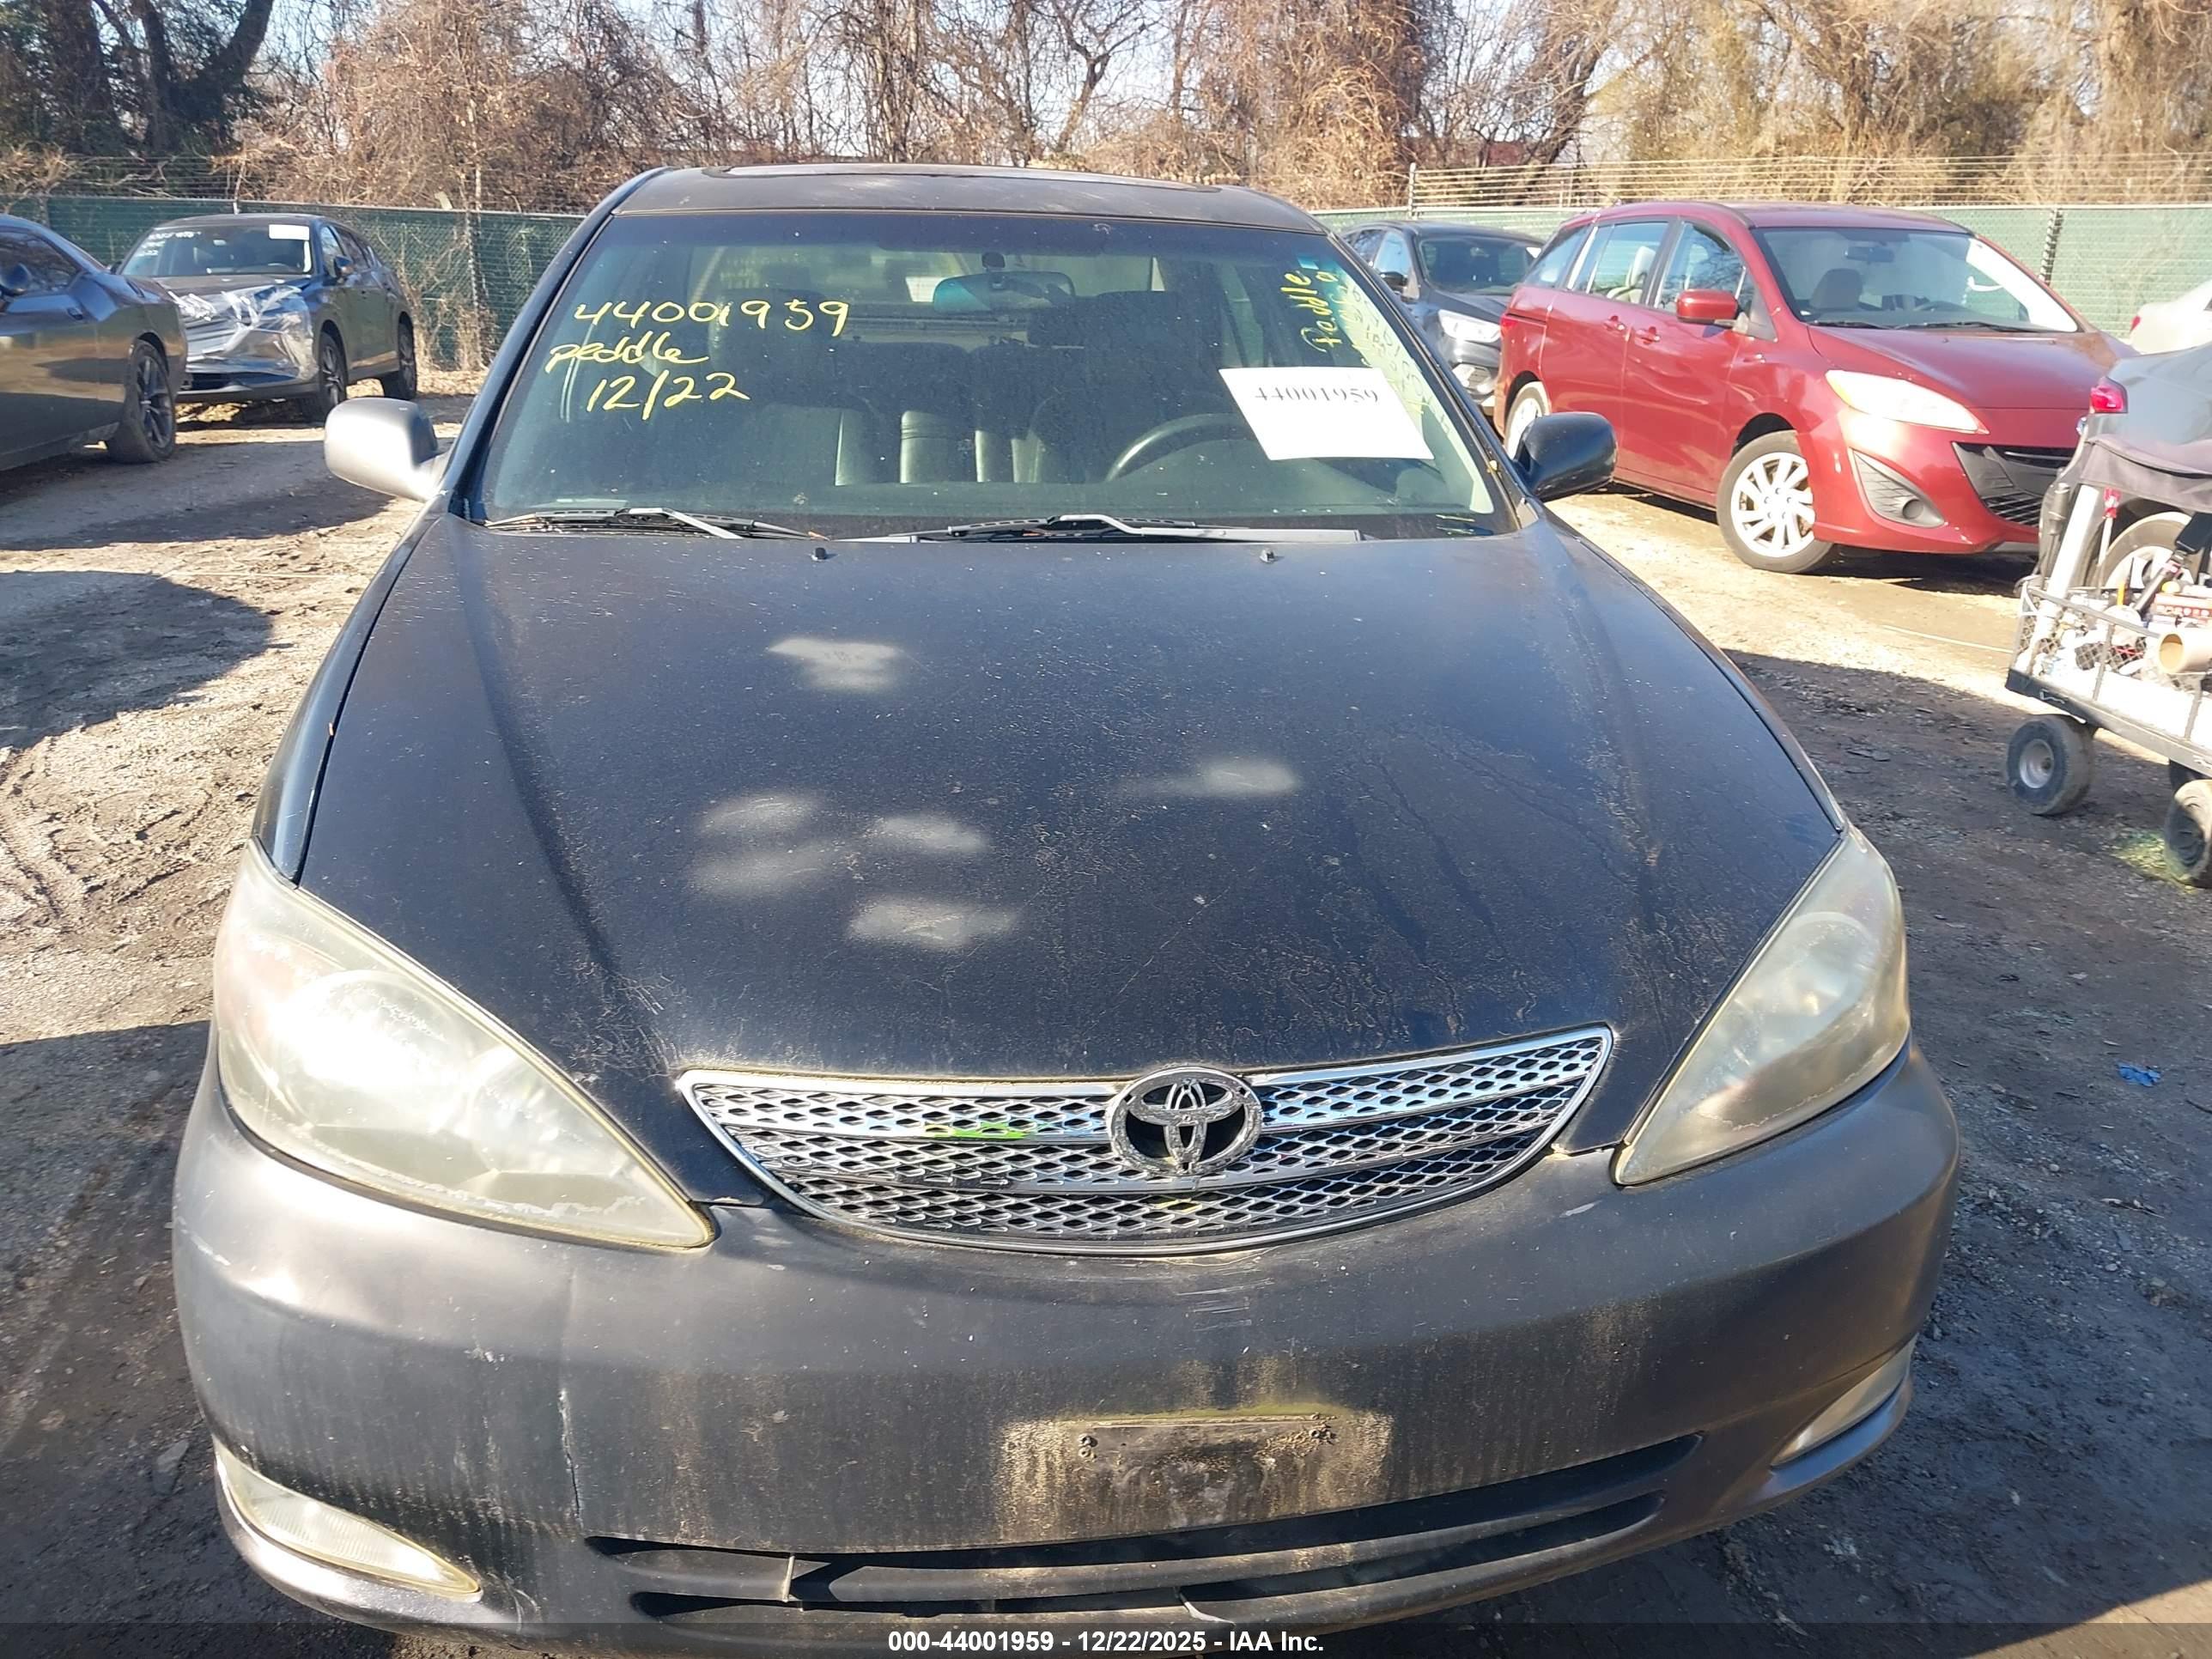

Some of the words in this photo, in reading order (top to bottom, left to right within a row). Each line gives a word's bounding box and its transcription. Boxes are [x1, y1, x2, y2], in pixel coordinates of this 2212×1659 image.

[574, 300, 850, 337] 44001959
[586, 369, 751, 421] 12/22
[1255, 385, 1379, 404] 44001959
